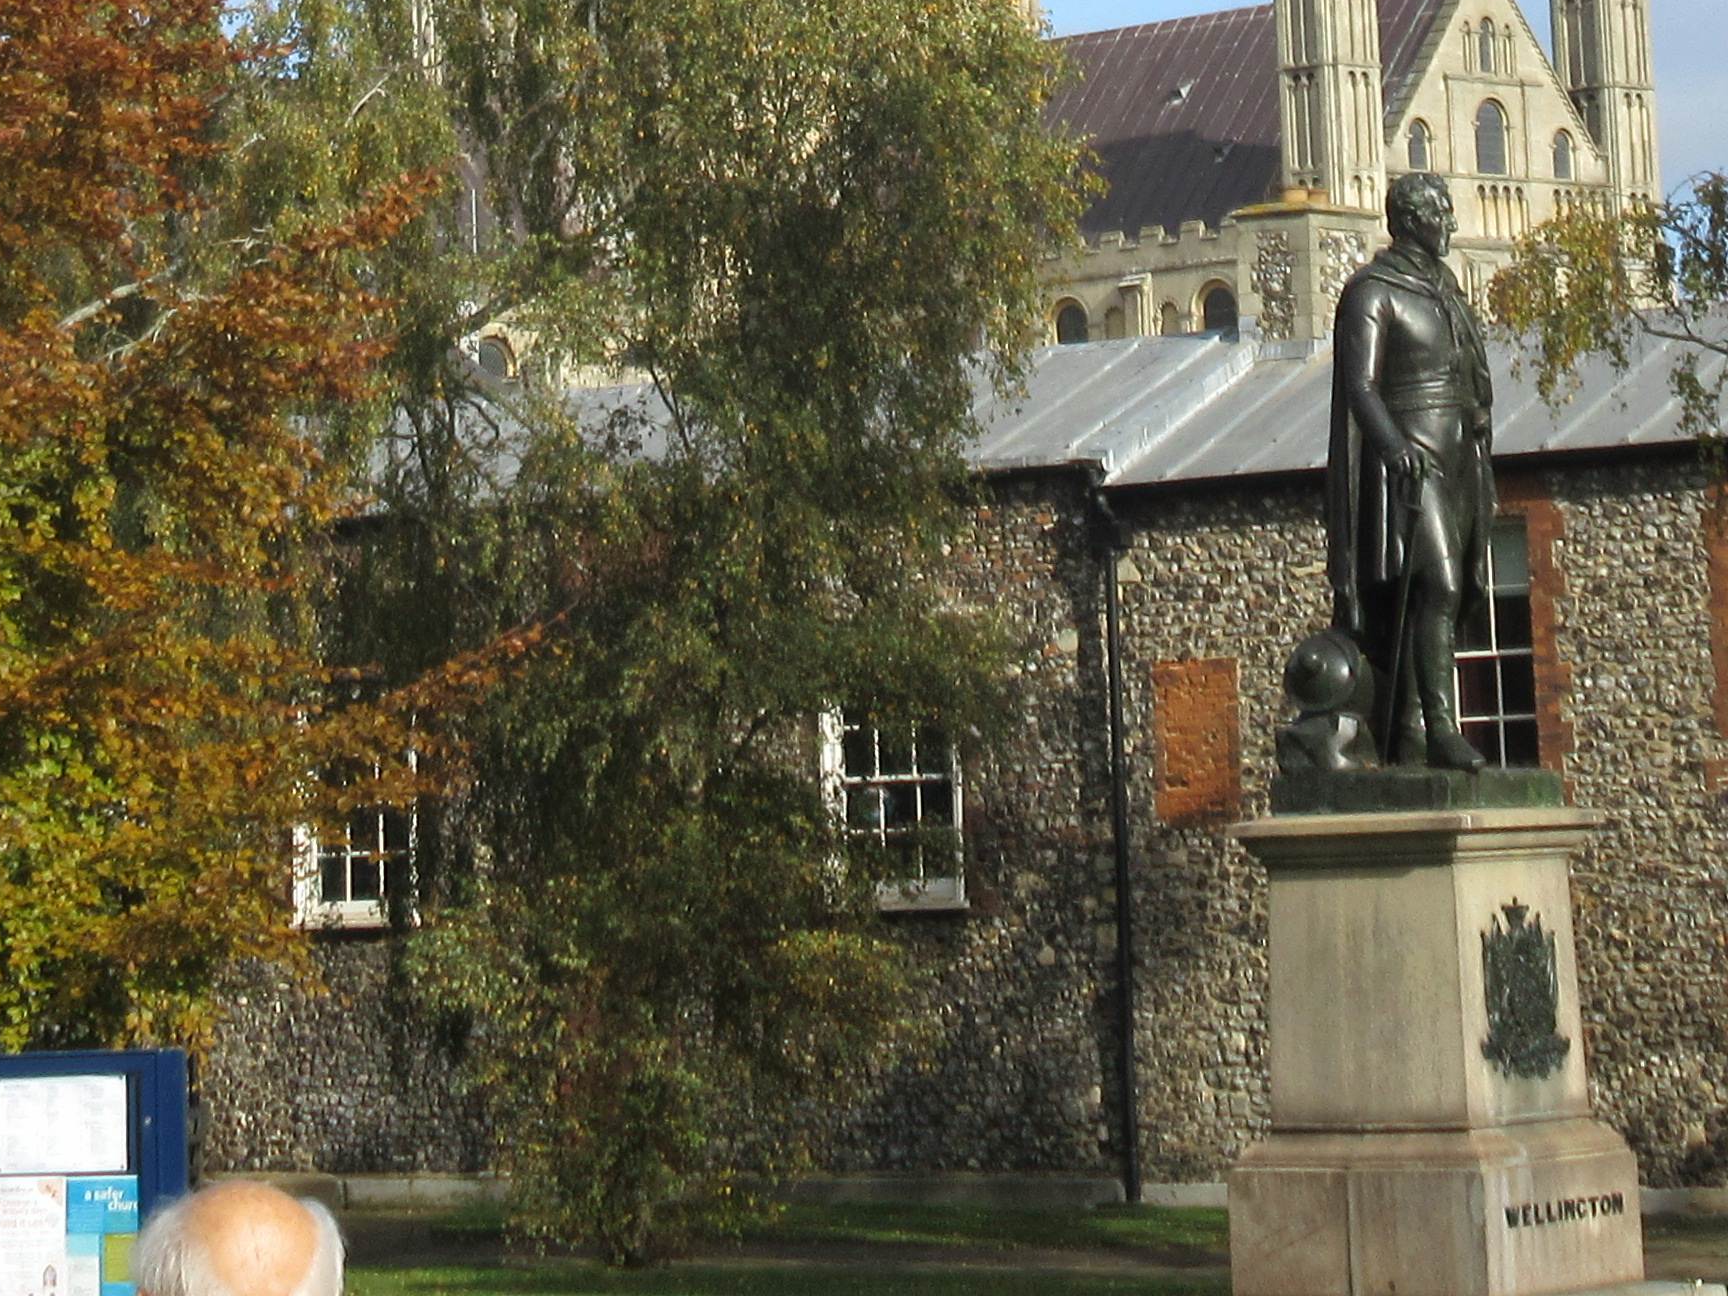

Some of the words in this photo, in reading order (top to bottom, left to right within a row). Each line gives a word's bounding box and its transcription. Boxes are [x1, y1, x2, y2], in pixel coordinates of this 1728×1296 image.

[84, 1189, 93, 1202] a
[94, 1186, 125, 1202] safer
[1504, 1192, 1624, 1229] WELLINGTON
